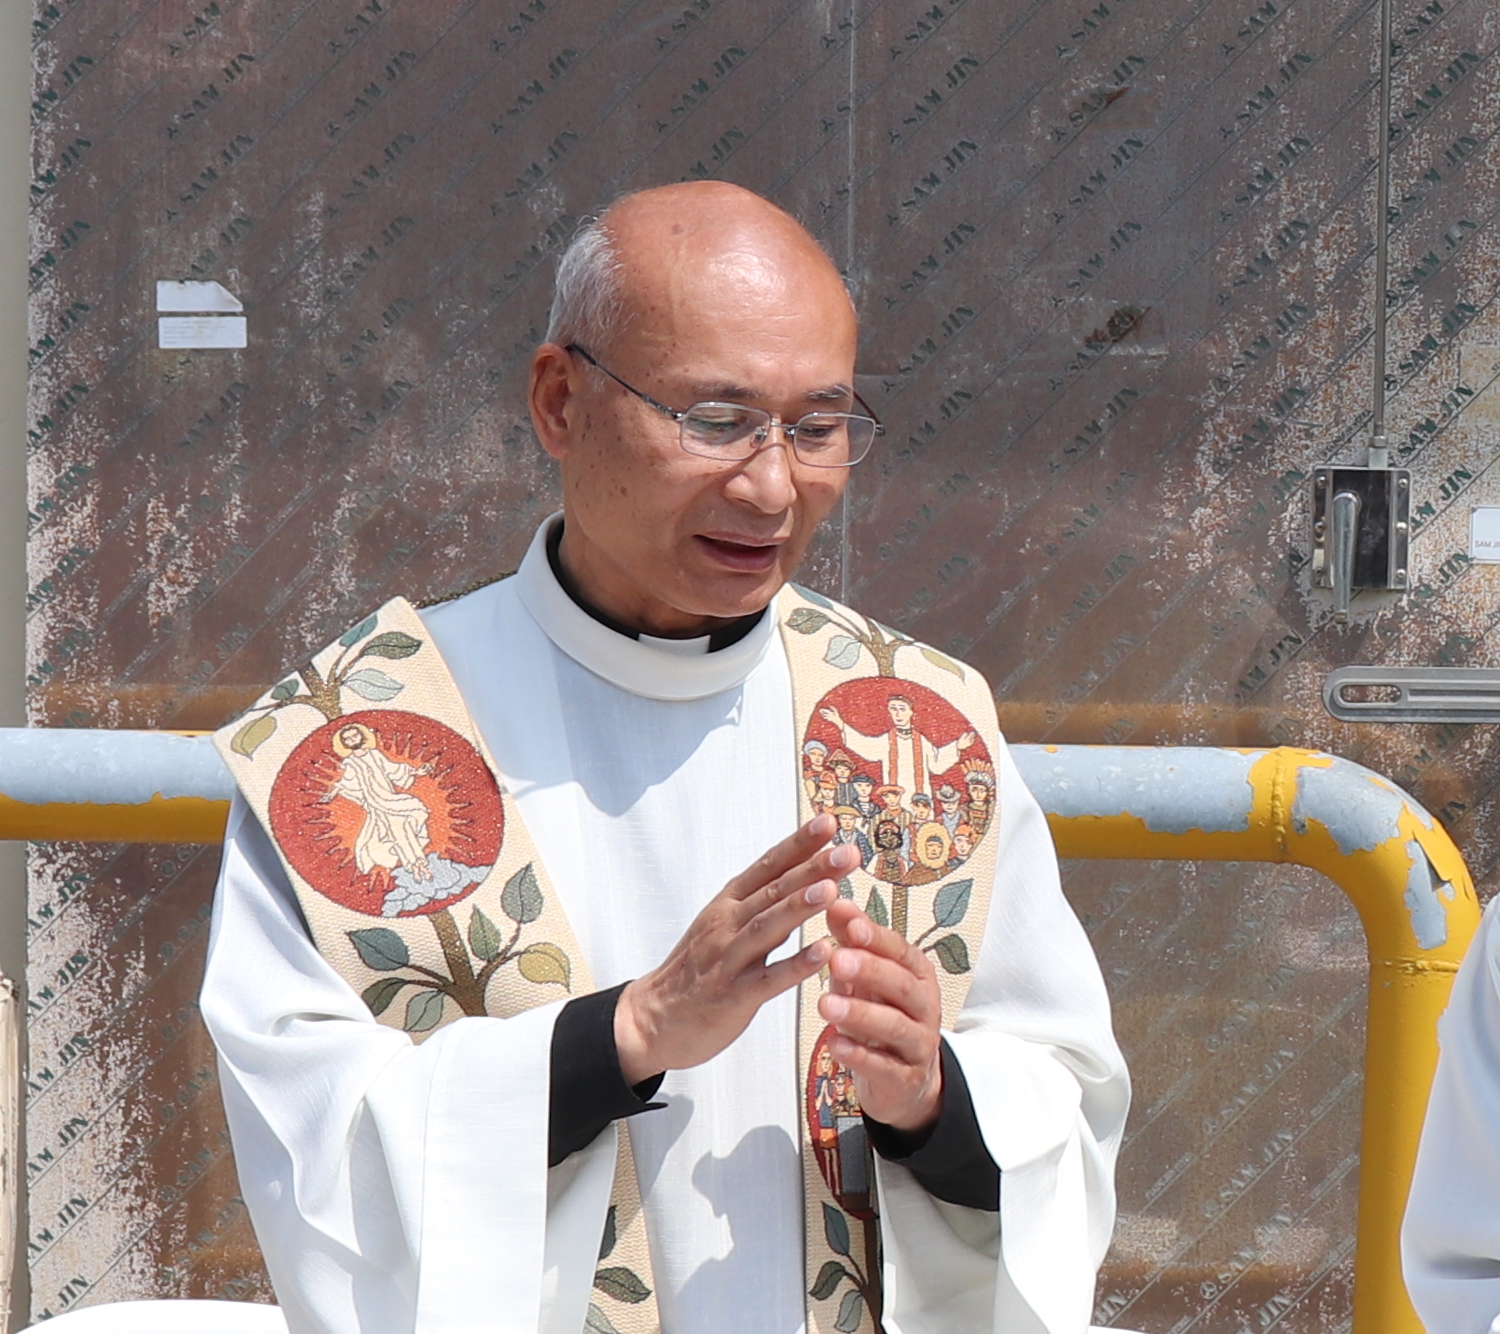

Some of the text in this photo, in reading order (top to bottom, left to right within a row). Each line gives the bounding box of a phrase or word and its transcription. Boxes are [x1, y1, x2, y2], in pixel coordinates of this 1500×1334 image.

[904, 3, 945, 46] SAM
[341, 79, 382, 122] SAM
[896, 419, 937, 462] SAM
